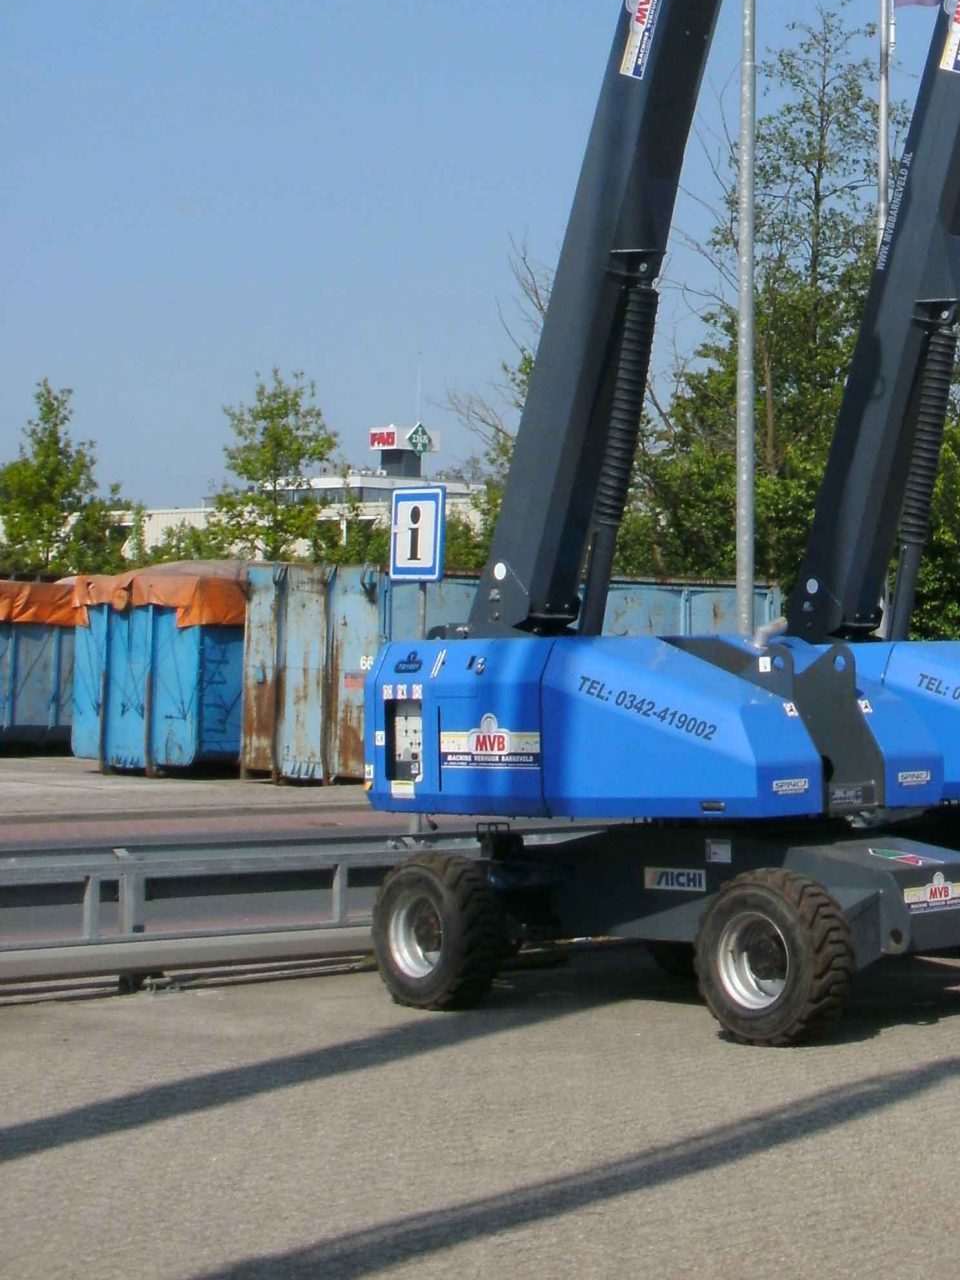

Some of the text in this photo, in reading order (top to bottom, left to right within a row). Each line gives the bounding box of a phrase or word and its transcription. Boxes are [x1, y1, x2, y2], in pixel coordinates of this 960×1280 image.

[918, 673, 949, 697] TEL:
[578, 676, 717, 741] TEL: 0342-419002
[475, 735, 506, 752] MVB
[657, 871, 703, 888] AICHI
[929, 886, 950, 899] MVB
